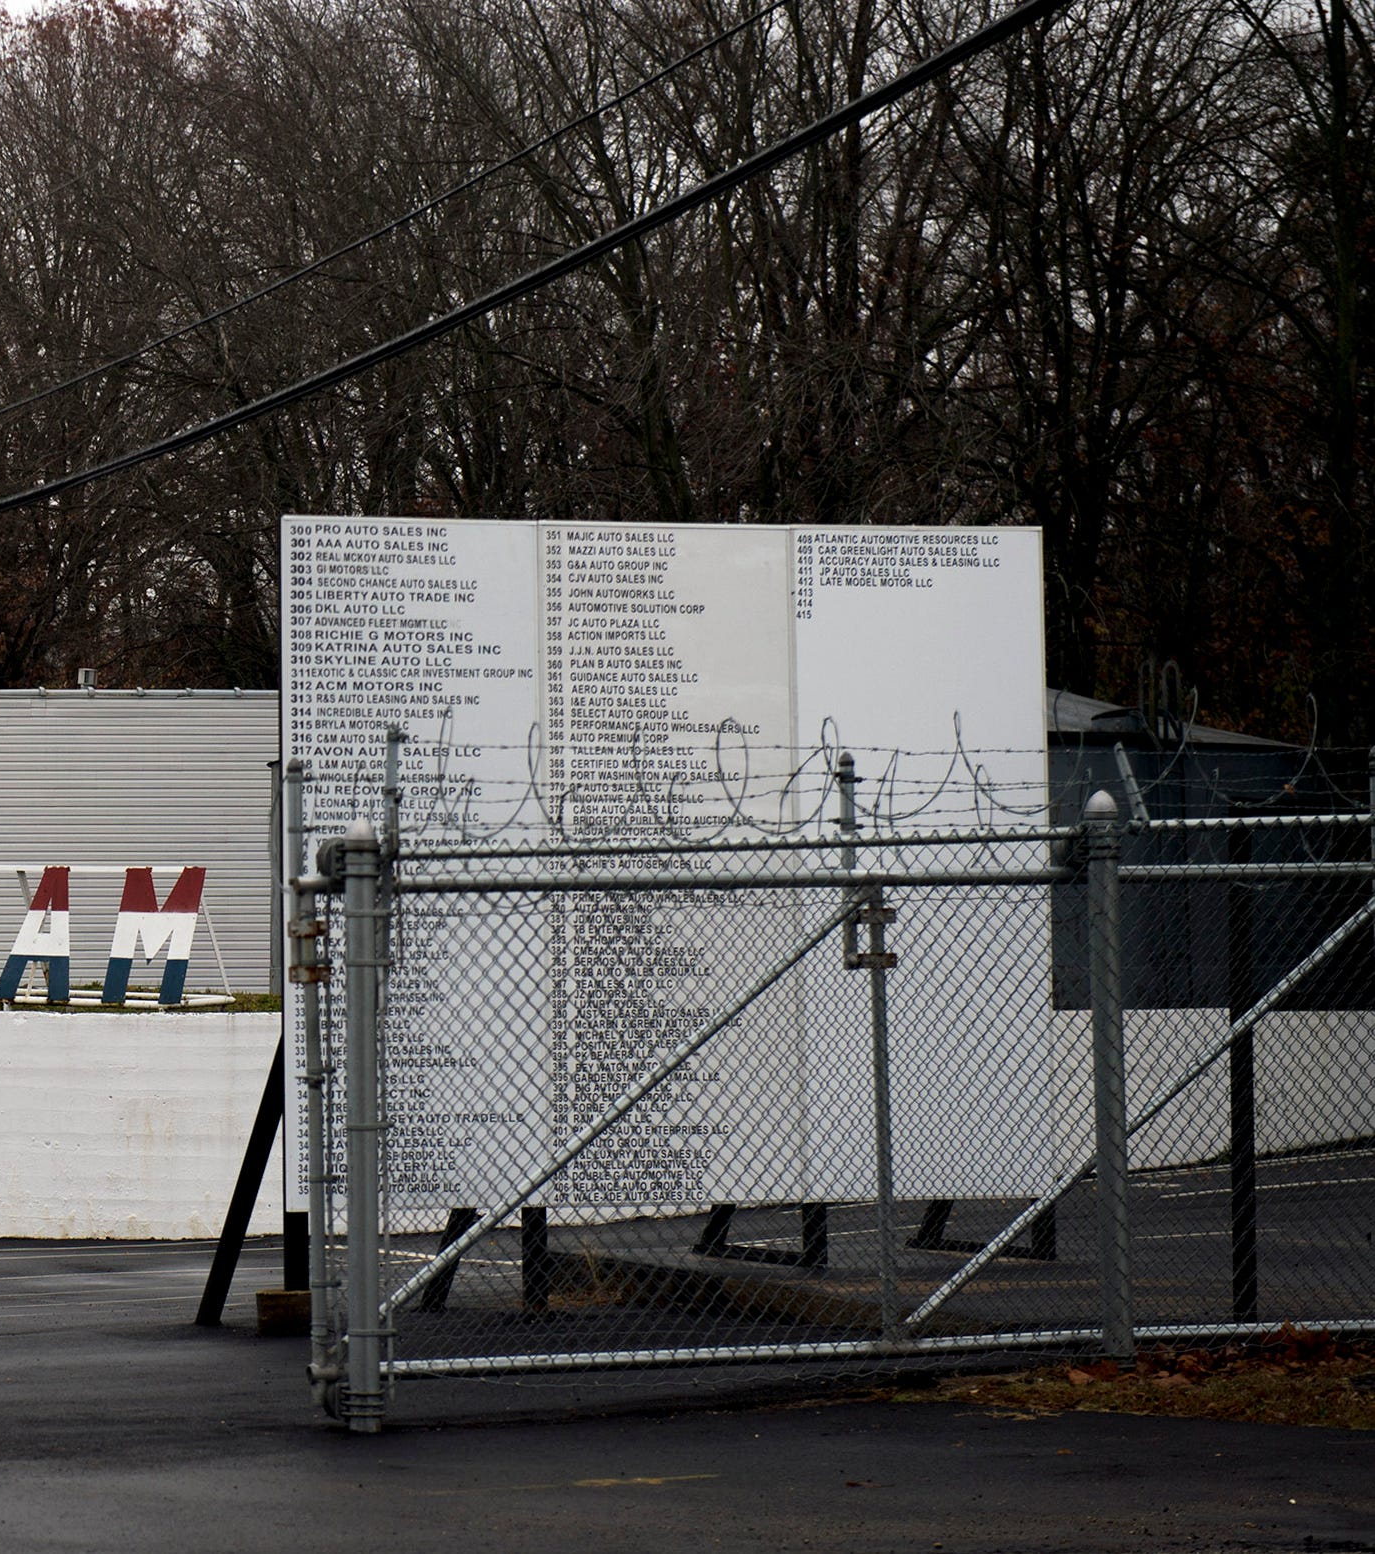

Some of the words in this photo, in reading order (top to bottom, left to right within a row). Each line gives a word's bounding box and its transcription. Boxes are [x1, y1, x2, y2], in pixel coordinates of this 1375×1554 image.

[290, 525, 312, 535] 300
[314, 524, 341, 535] PRO
[344, 524, 379, 536] AUTO
[382, 525, 423, 537] SALES
[426, 527, 447, 537] INC
[546, 530, 561, 540] 351
[566, 531, 595, 541] MAJIC
[596, 531, 622, 542] AUTO
[624, 532, 655, 543] SALES
[657, 532, 674, 543] LLC
[290, 537, 311, 548] 301
[315, 538, 342, 548] AAA
[345, 538, 380, 550] AUTO
[383, 540, 424, 551] SALES
[428, 541, 448, 552] INC
[796, 534, 813, 544] 408
[813, 533, 858, 544] ATLANTIC
[860, 534, 920, 545] AUTOMOTIVE
[922, 534, 979, 545] RESOURCES
[981, 535, 998, 545] LLC
[546, 545, 561, 555] 352
[568, 545, 596, 556] MAZZI
[598, 545, 624, 556] AUTO
[626, 546, 656, 557] SALES
[658, 546, 676, 557] LLC
[797, 545, 813, 555] 409
[817, 545, 837, 555] CAR
[839, 545, 899, 556] GREENLIGHT
[900, 546, 926, 556] AUTO
[927, 546, 958, 556] SALES
[960, 546, 978, 557] LLC
[290, 551, 312, 561] 302
[315, 551, 341, 562] REAL
[343, 552, 376, 563] MCKOY
[377, 553, 404, 564] AUTO
[405, 554, 436, 565] SALES
[438, 554, 456, 566] LLC
[797, 555, 813, 565] 410
[818, 555, 870, 566] ACCURACY
[871, 556, 897, 567] AUTO
[898, 557, 929, 567] SALES
[931, 557, 938, 567] &
[940, 557, 980, 567] LEASING
[982, 557, 1000, 568] LLC
[290, 564, 312, 574] 303
[328, 564, 369, 575] MOTORS
[370, 565, 389, 576] LLC
[546, 559, 562, 570] 353
[567, 559, 587, 570] G&A
[589, 559, 615, 570] AUTO
[617, 560, 650, 571] GROUP
[652, 561, 668, 571] INC
[546, 573, 562, 583] 354
[568, 572, 587, 583] CJV
[587, 573, 613, 584] AUTO
[615, 573, 646, 584] SALES
[647, 574, 664, 584] INC
[797, 566, 812, 575] 411
[819, 566, 831, 576] JP
[832, 566, 858, 577] AUTO
[859, 567, 890, 577] SALES
[892, 567, 910, 578] LLC
[290, 576, 313, 586] 304
[317, 576, 357, 588] SECOND
[358, 577, 397, 588] CHANCE
[399, 578, 425, 589] AUTO
[427, 579, 458, 590] SALES
[459, 579, 478, 590] LLC
[798, 576, 813, 586] 412
[819, 576, 842, 587] LATE
[845, 576, 877, 587] MODEL
[880, 577, 913, 588] MOTOR
[915, 577, 933, 588] LLC
[289, 589, 312, 600] 305
[315, 589, 368, 601] LIBERTY
[370, 591, 405, 602] AUTO
[408, 592, 450, 602] TRADE
[454, 592, 475, 603] INC
[546, 587, 562, 597] 355
[568, 587, 593, 598] JOHN
[595, 588, 655, 599] AUTOWORKS
[657, 589, 675, 600] LLC
[797, 587, 813, 597] 413
[546, 601, 562, 612] 356
[568, 602, 628, 613] AUTOMOTIVE
[630, 603, 677, 614] SOLUTION
[679, 604, 705, 614] CORP
[796, 598, 813, 607] 414
[289, 603, 312, 614] 306
[314, 603, 340, 614] DKL
[343, 603, 378, 615] AUTO
[382, 604, 405, 615] LLC
[795, 609, 812, 619] 415
[290, 615, 312, 626] 307
[314, 616, 366, 628] ADVANCED
[368, 617, 398, 628] FLEET
[399, 618, 428, 629] MGMT
[429, 619, 447, 630] LLC
[546, 616, 562, 626] 357
[567, 617, 579, 628] JC
[581, 617, 607, 628] AUTO
[609, 618, 640, 628] PLAZA
[642, 618, 660, 629] LLC
[290, 629, 312, 640] 308
[314, 629, 363, 640] RICHIE
[368, 630, 379, 641] G
[384, 631, 445, 641] MOTORS
[449, 631, 473, 642] INC
[546, 631, 562, 641] 358
[567, 630, 602, 640] ACTION
[605, 630, 646, 640] IMPORTS
[648, 630, 666, 640] LLC
[290, 641, 312, 652] 309
[314, 641, 378, 653] KATRINA
[382, 643, 422, 654] AUTO
[426, 643, 473, 654] SALES
[478, 644, 501, 655] INC
[547, 645, 563, 656] 359
[595, 645, 622, 656] AUTO
[624, 646, 654, 656] SALES
[656, 646, 674, 657] LLC
[290, 654, 312, 664] 310
[314, 655, 376, 665] SKYLINE
[380, 656, 421, 666] AUTO
[425, 656, 452, 667] LLC
[348, 668, 354, 678] &
[357, 667, 398, 678] CLASSIC
[400, 667, 420, 678] CAR
[422, 668, 480, 678] INVESTMENT
[483, 668, 515, 678] GROUP
[517, 668, 533, 678] INC
[290, 680, 312, 690] 312
[315, 680, 347, 691] ACM
[352, 680, 414, 692] MOTORS
[419, 681, 443, 692] INC
[628, 979, 653, 989] AUTO
[416, 1113, 451, 1123] AUTO
[455, 1113, 498, 1123] TRADE
